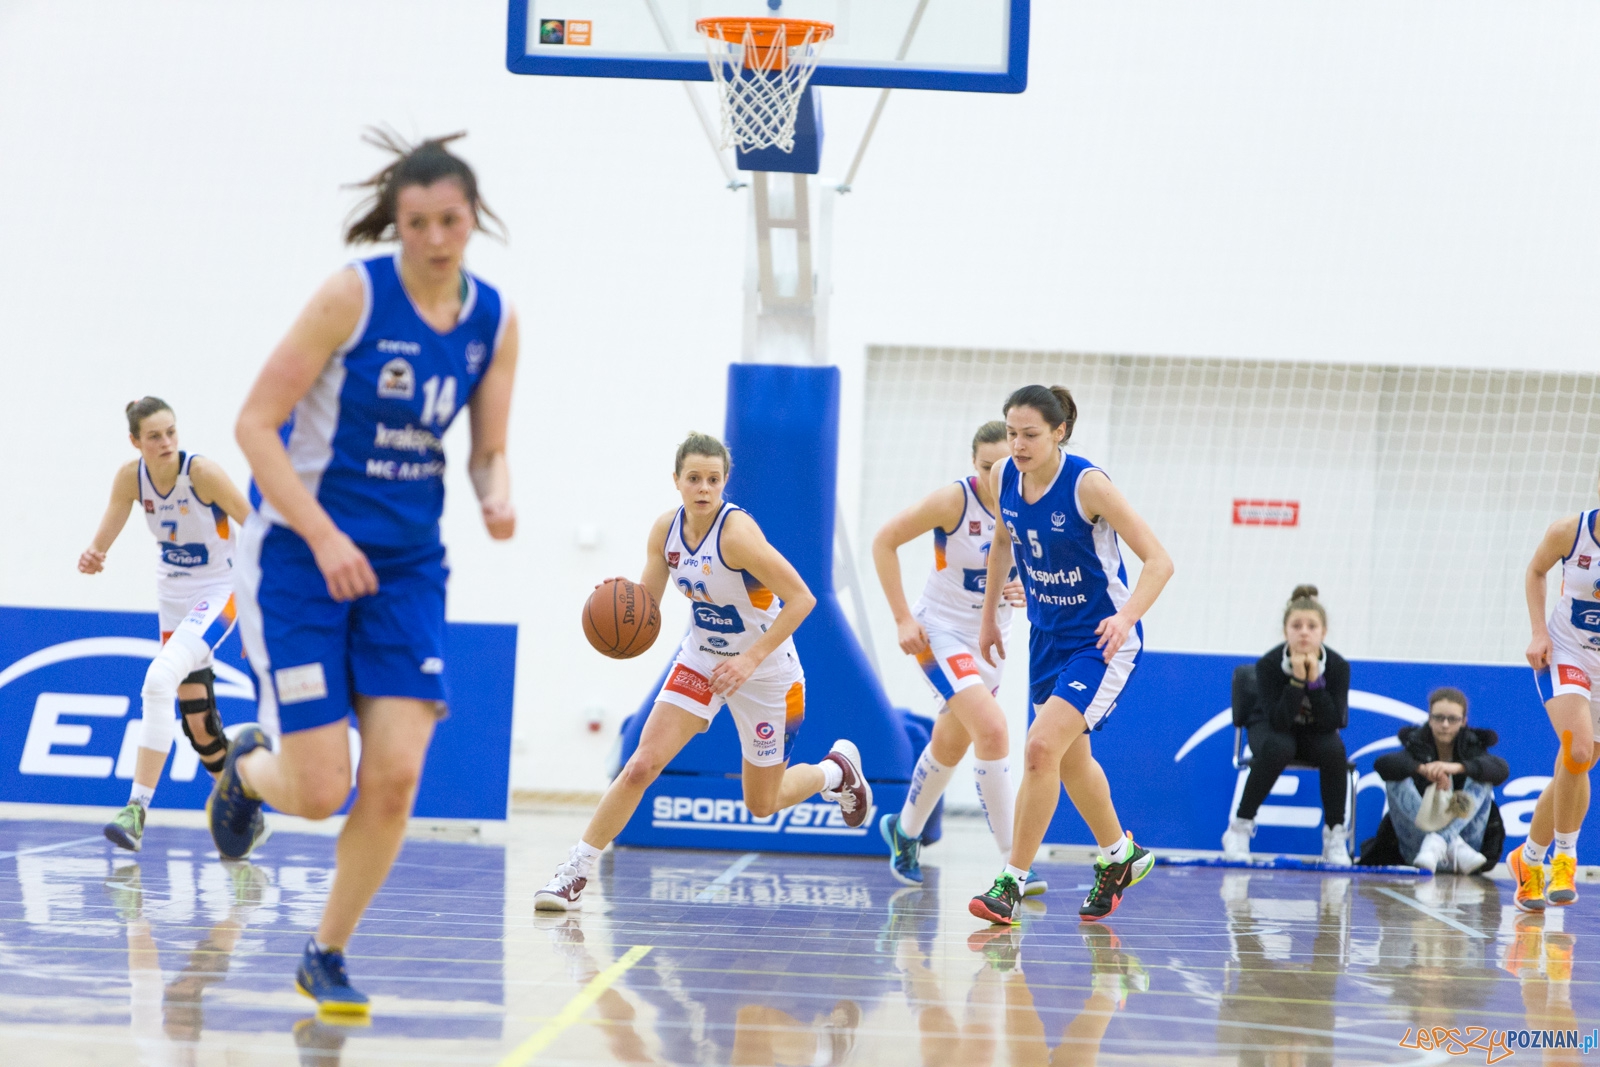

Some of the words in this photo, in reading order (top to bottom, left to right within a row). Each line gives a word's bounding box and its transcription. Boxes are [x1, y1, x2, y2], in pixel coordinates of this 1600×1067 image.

[421, 375, 457, 427] 14
[161, 520, 178, 542] 7
[1027, 529, 1043, 558] 5
[1038, 593, 1087, 606] ARTHUR
[699, 611, 733, 626] Enea
